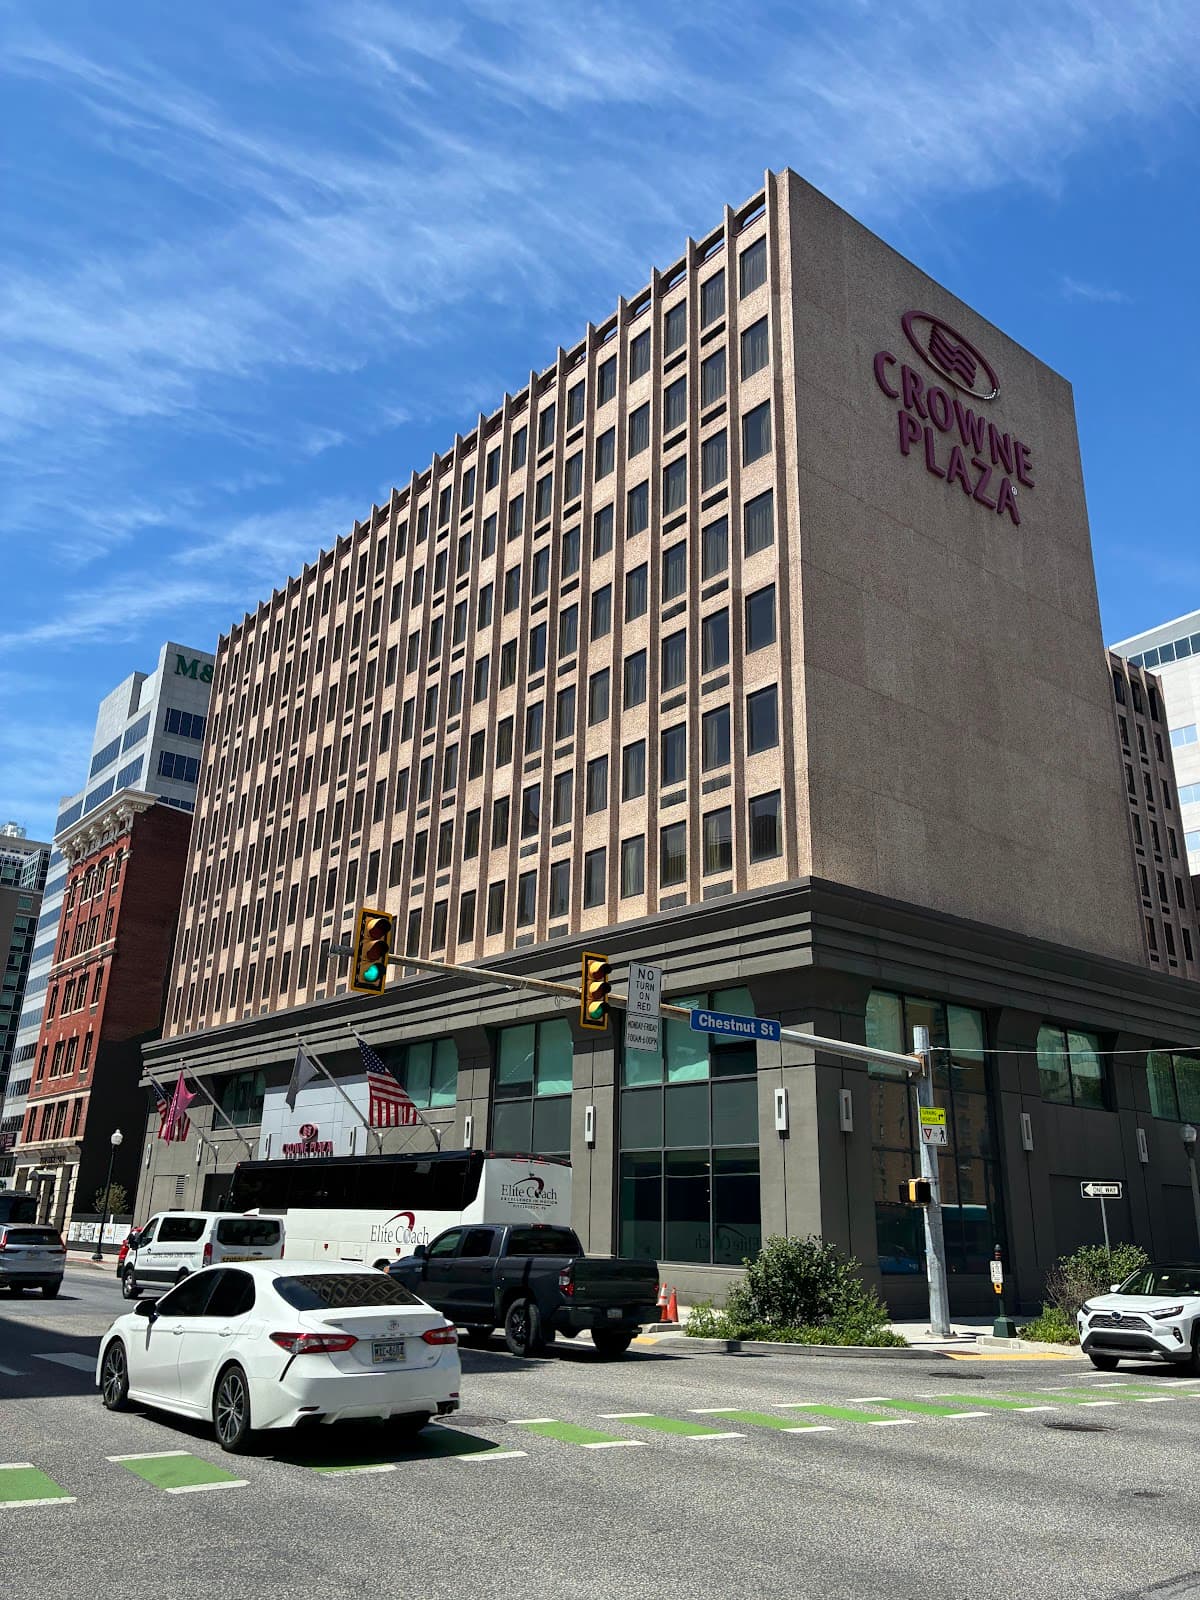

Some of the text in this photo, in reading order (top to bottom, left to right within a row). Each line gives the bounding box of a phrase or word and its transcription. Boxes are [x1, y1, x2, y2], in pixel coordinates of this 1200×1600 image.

[874, 350, 1035, 488] CROWNE
[898, 410, 1021, 526] PLAZA
[637, 968, 654, 981] NO
[636, 980, 655, 992] TURN
[639, 991, 650, 1001] ON
[637, 1001, 651, 1011] RED
[698, 1013, 774, 1037] Chestnut St
[282, 1141, 334, 1156] CROWNE PLAZA
[501, 1184, 558, 1200] Elite Coach
[1092, 1186, 1117, 1195] ONE WAY
[370, 1224, 430, 1245] Elite Coach
